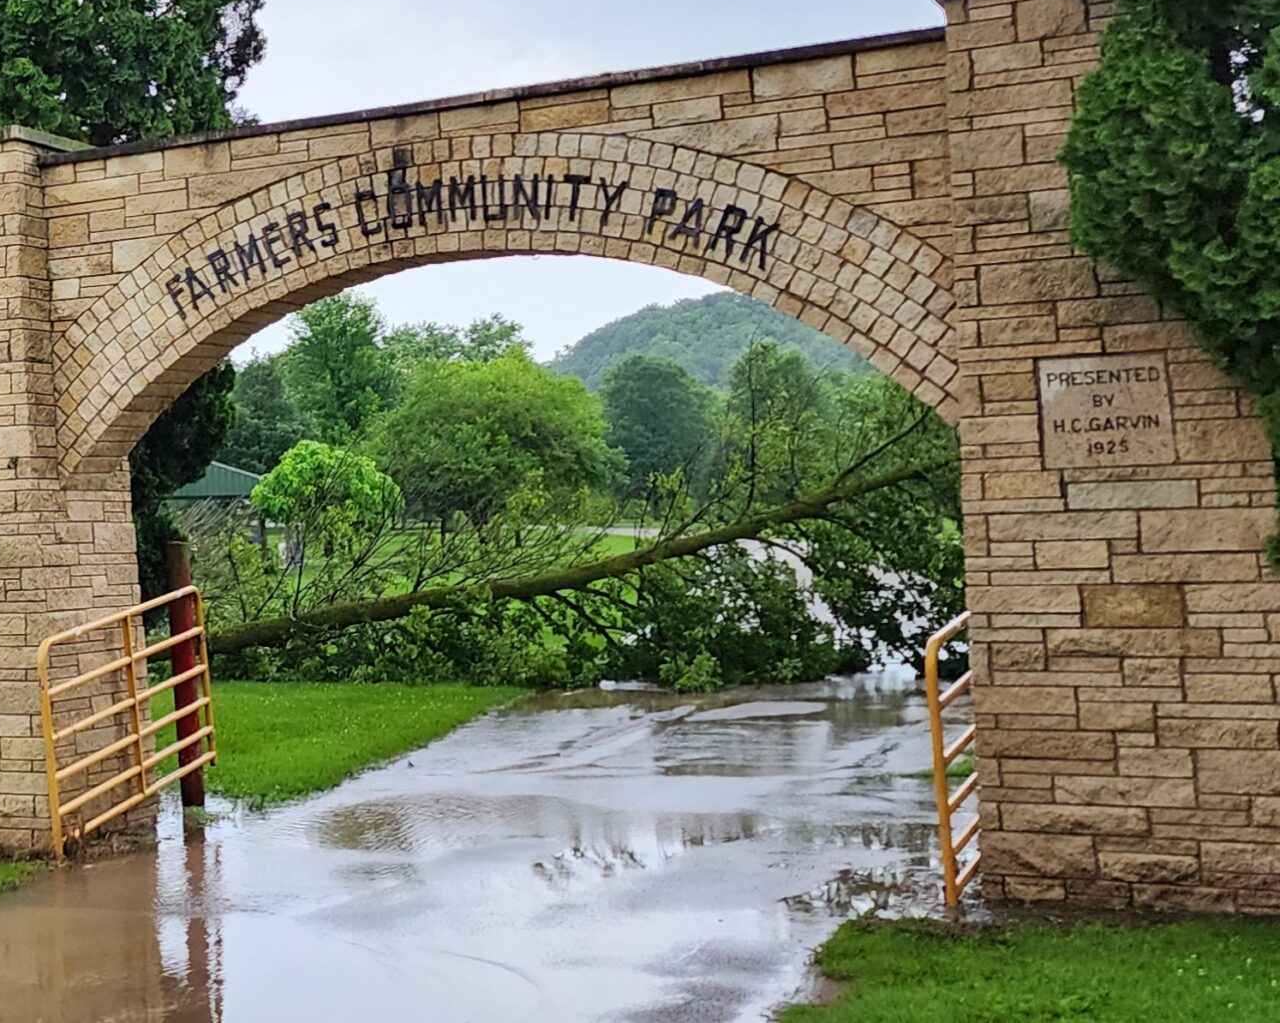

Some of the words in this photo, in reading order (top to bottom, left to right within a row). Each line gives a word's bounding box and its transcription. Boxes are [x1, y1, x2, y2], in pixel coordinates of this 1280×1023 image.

[166, 203, 338, 320] FARMERS
[355, 173, 628, 237] COMMUNITY
[646, 187, 780, 271] PARK
[1046, 366, 1160, 388] PRESENTED
[1093, 393, 1114, 408] BY
[1087, 435, 1129, 456] 1925
